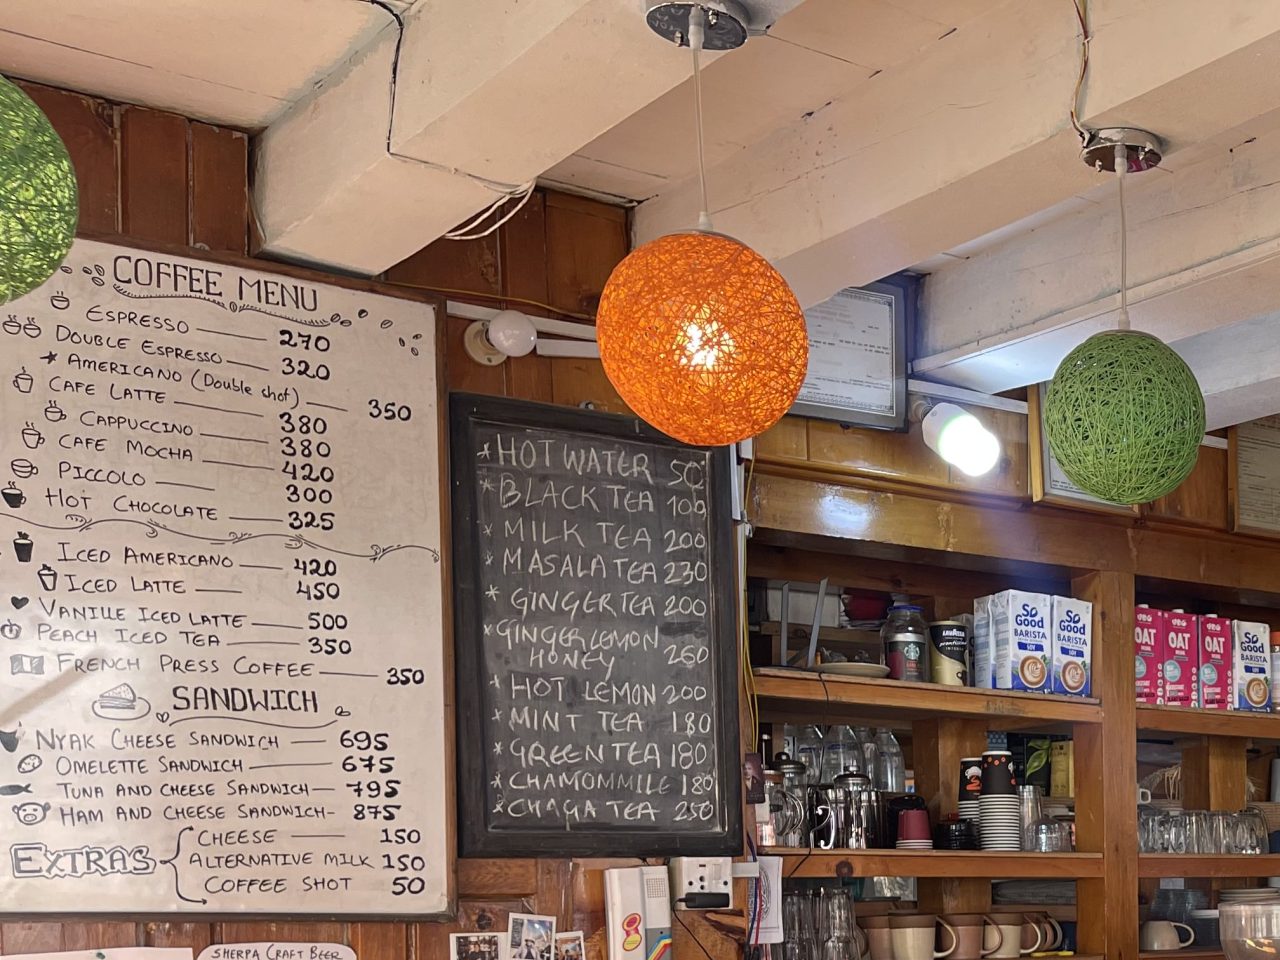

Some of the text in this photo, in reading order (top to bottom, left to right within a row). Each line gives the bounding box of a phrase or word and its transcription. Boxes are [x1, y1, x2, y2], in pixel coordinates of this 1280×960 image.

[113, 255, 318, 311] COFFEE MENU
[86, 306, 330, 351] ESPRESSO 270
[56, 325, 330, 379] DOUBLE ESPRESSO 320
[68, 354, 182, 382] AMERICANO
[191, 370, 252, 396] (Double
[369, 400, 412, 421] 350
[49, 377, 327, 434] CAFE LATTE 380
[80, 411, 331, 457] CAPPUCCINO 380
[58, 435, 334, 483] CAFE MOCHA 420
[497, 434, 555, 469] HOT
[563, 449, 652, 485] WATER
[58, 462, 332, 505] PICCOLO 300
[500, 474, 706, 518] BLACK TEA 100
[45, 488, 334, 530] HOT CHOCOLATE 325
[504, 520, 706, 552] MILK TEA 200
[57, 542, 337, 576] ICED AMERICANO 420
[503, 548, 707, 584] MASALA TEA 230
[68, 577, 340, 600] ICED LATTE 450
[38, 597, 348, 630] VANILLE ICED LATTE 500
[510, 591, 706, 623] GINGER TEA 200
[1022, 604, 1037, 617] So
[1066, 610, 1081, 624] So
[1014, 629, 1047, 639] BARISTA
[1015, 614, 1044, 629] Good
[1059, 621, 1085, 635] Good
[38, 624, 351, 655] PEACH ICED TEA 350
[496, 623, 658, 652] GINGER LEMON
[1057, 634, 1088, 647] BARISTA
[1135, 627, 1156, 645] OAT
[1169, 632, 1190, 649] OAT
[1205, 636, 1225, 653] OAT
[1241, 642, 1264, 653] Good
[1245, 632, 1258, 644] So
[57, 653, 425, 685] FRENCH PRESS COFFEE 350
[529, 646, 710, 680] HONEY 260
[1241, 654, 1267, 663] BARISTA
[172, 686, 318, 713] SANDWICH
[512, 676, 706, 706] HOT LEMON 200
[510, 709, 711, 735] MINT TEA 180
[36, 729, 390, 751] NYAK CHEESE SANDWICH 695
[56, 755, 395, 776] OMELETTE SANDWICH 675
[510, 742, 706, 769] GREEN TEA 180
[57, 780, 401, 799] TUNA AND CHEESE SANDWICH 795
[682, 773, 713, 796] 180
[60, 806, 103, 827] HAM
[116, 805, 152, 819] AND
[163, 805, 225, 820] CHEESE
[353, 804, 401, 821] 875
[606, 800, 660, 822] TEA
[674, 800, 714, 822] 250
[198, 828, 420, 847] CHEESE 150
[11, 844, 155, 878] EXTRAS
[189, 852, 425, 872] ALTERNATIVE MILK 150
[204, 876, 425, 896] COFFEE SHOT 50
[211, 944, 343, 960] SHERPA CRAFT BEER
